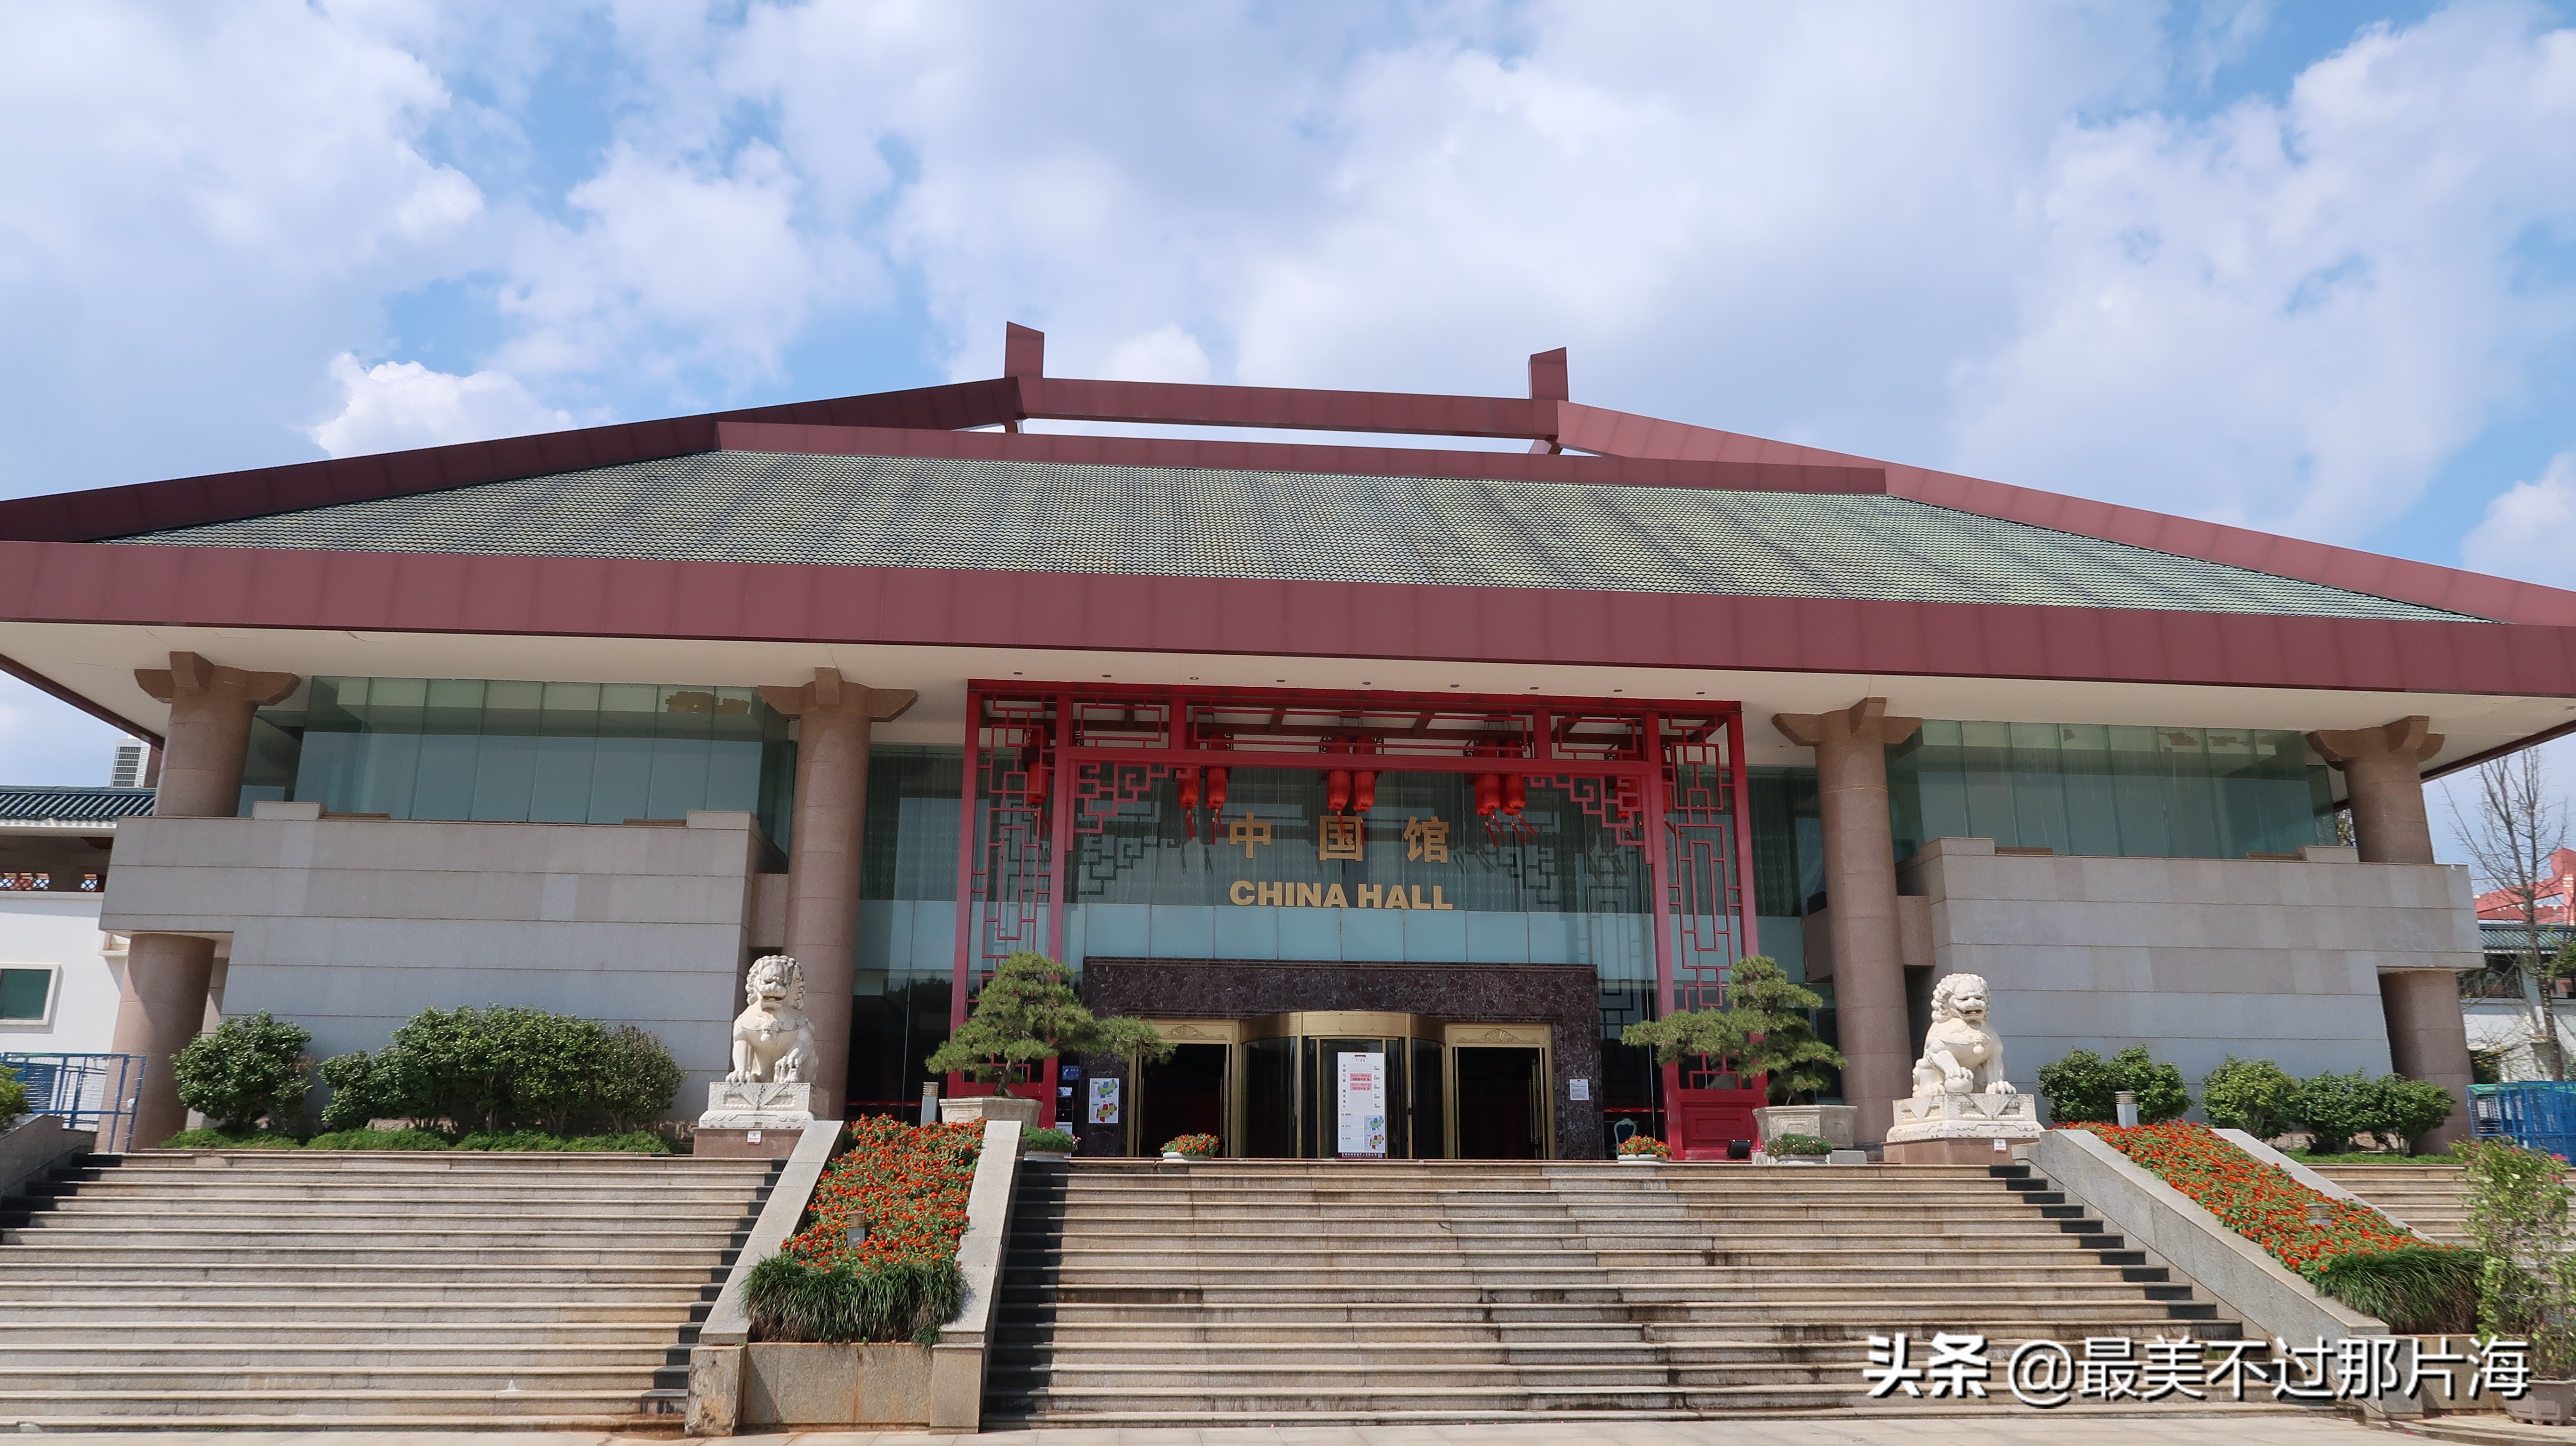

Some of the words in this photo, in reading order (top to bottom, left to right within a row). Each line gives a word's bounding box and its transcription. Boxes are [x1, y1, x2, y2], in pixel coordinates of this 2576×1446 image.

[1229, 811, 1449, 863] 中国馆
[1230, 880, 1349, 908] CHINA
[1358, 884, 1453, 910] HALL
